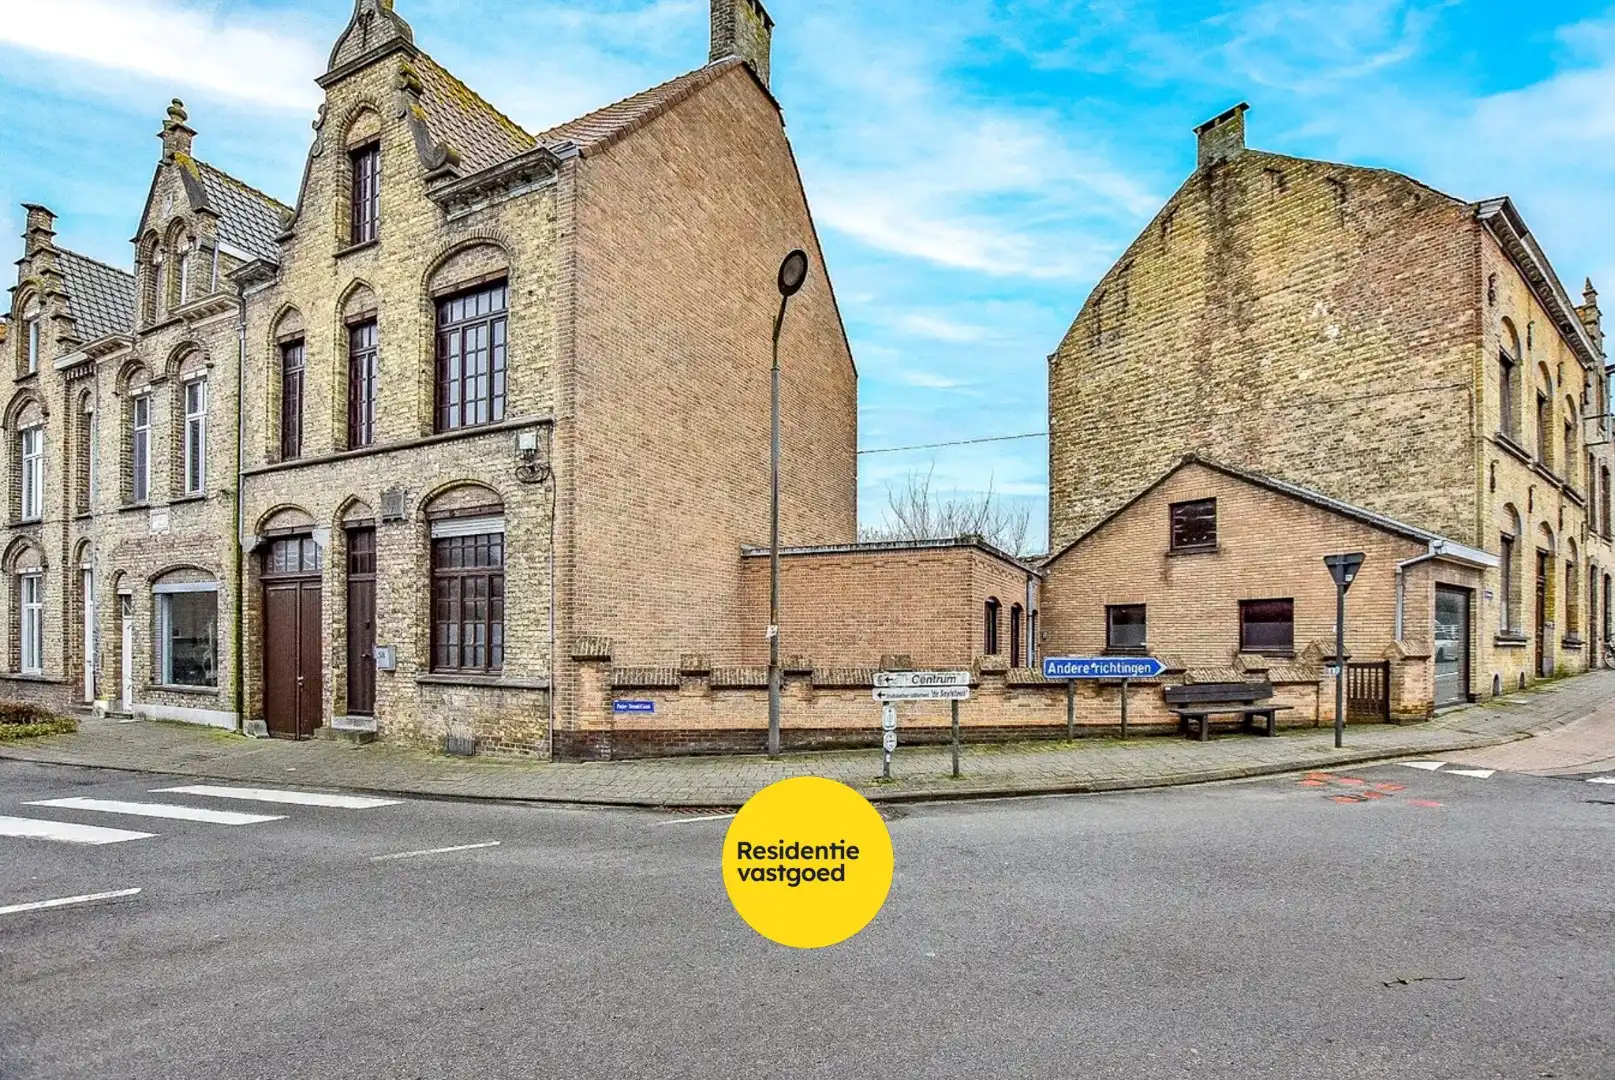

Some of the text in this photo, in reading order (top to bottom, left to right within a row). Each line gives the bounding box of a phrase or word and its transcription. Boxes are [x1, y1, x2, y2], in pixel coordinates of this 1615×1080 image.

[1048, 661, 1151, 677] Andere richtingen
[911, 674, 957, 684] Centrum
